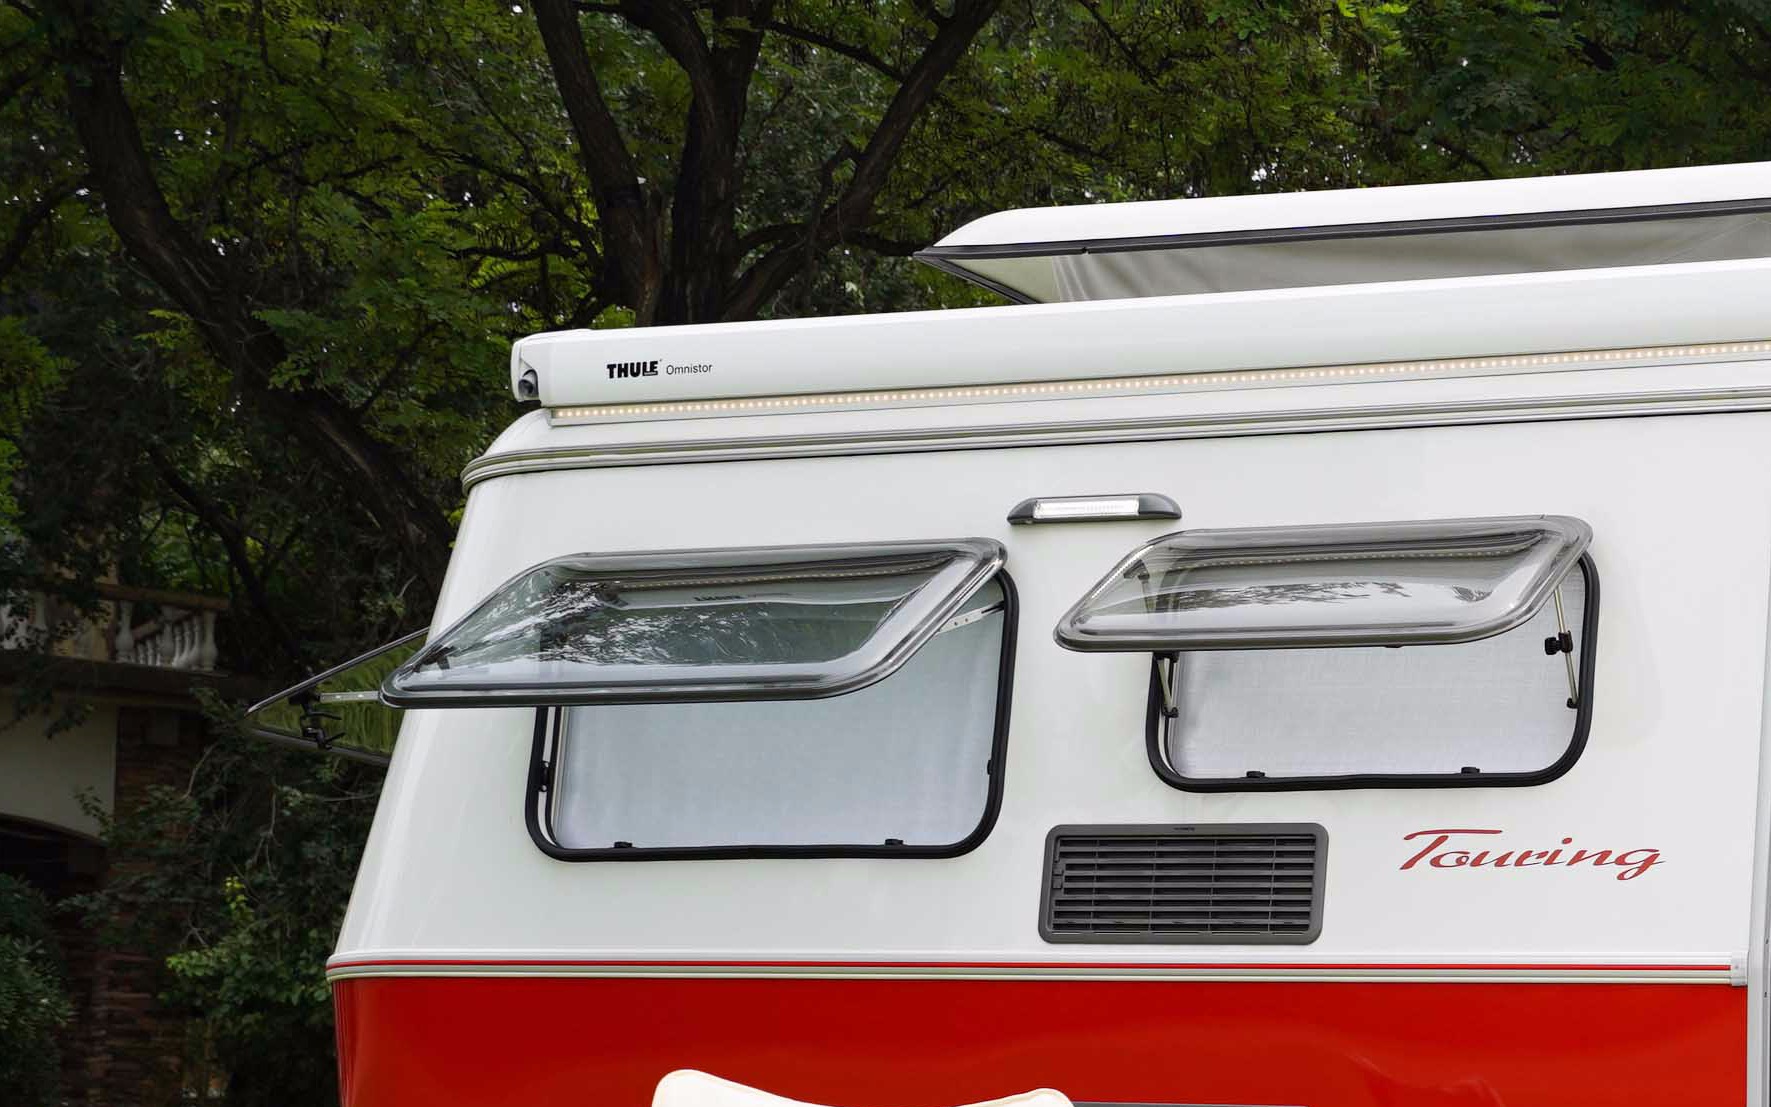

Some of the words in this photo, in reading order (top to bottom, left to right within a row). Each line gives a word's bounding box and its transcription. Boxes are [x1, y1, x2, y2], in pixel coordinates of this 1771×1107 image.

[606, 360, 659, 379] THULE
[666, 363, 713, 376] Omnistor
[1399, 828, 1666, 881] Touring
